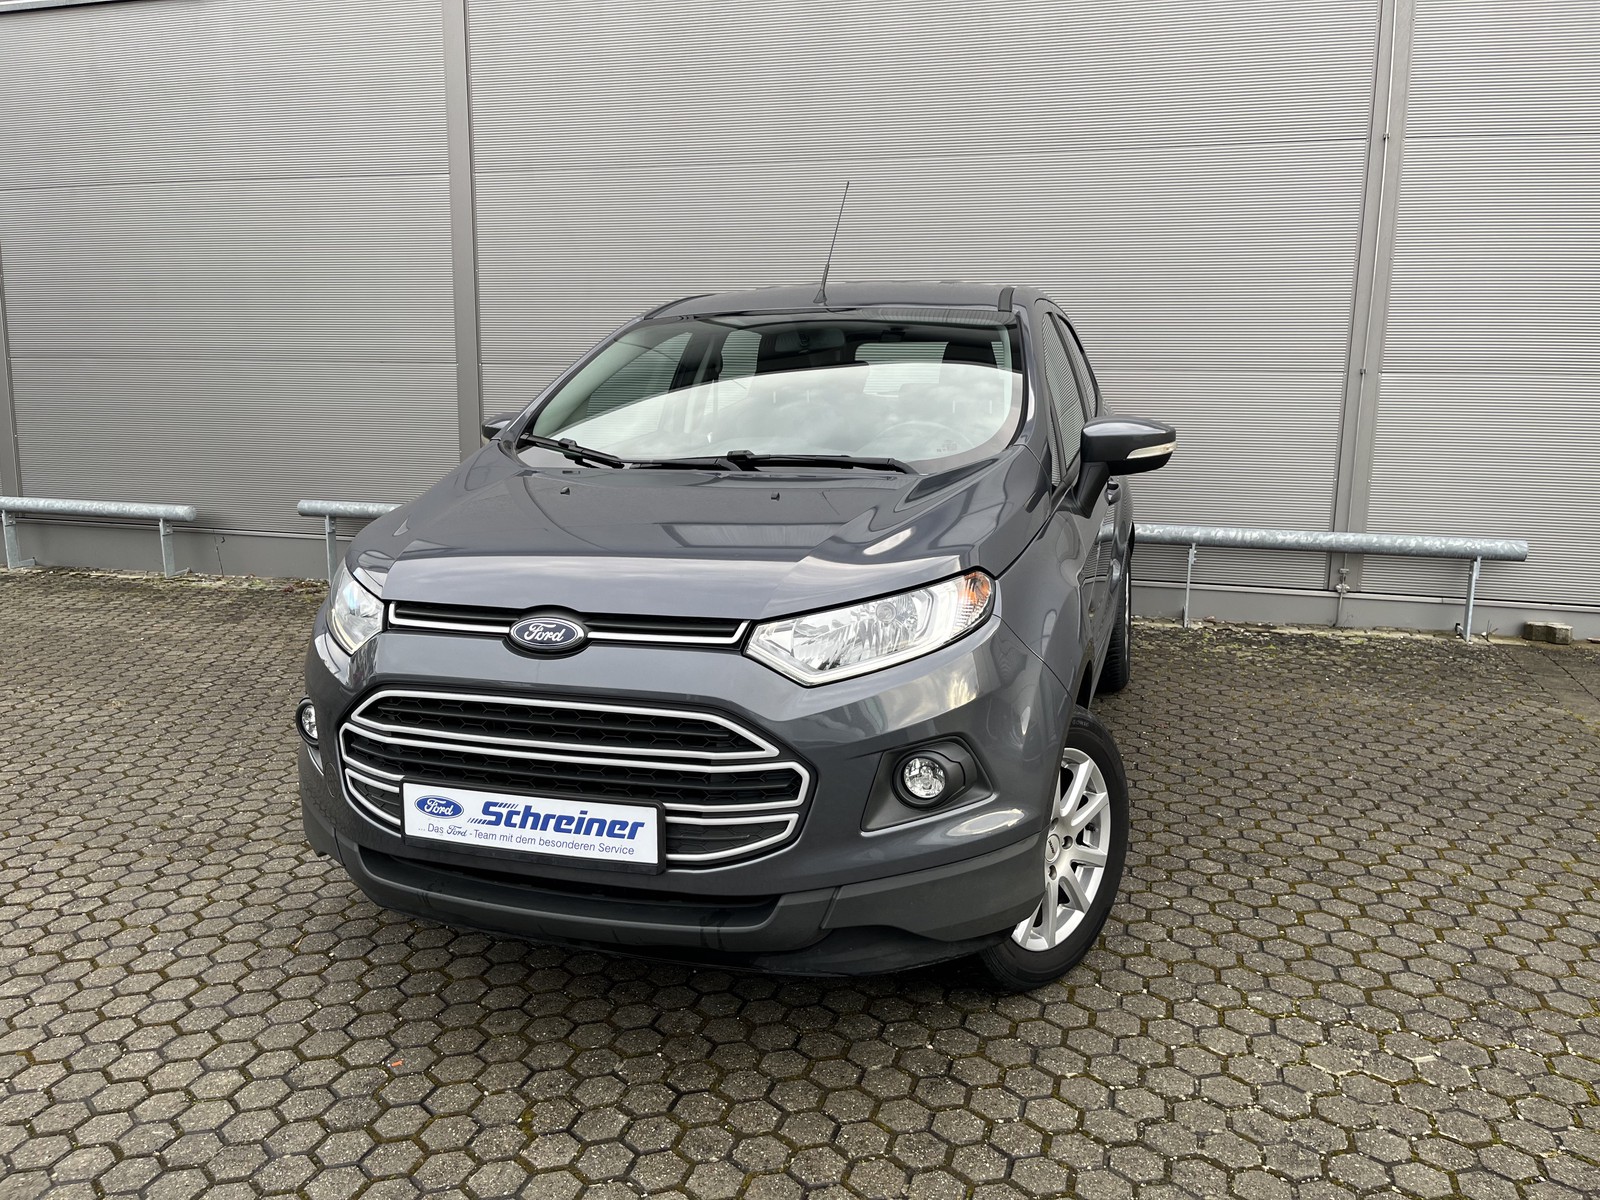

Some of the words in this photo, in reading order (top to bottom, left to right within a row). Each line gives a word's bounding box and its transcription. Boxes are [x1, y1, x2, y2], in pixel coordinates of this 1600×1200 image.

[523, 622, 566, 642] Ford
[424, 798, 454, 816] Ford
[480, 800, 646, 840] Schreiner
[427, 822, 444, 834] Das
[446, 824, 468, 838] Ford
[499, 833, 514, 841] mit
[515, 833, 537, 846] dem
[538, 836, 596, 852] besonderen
[597, 842, 635, 856] Service
